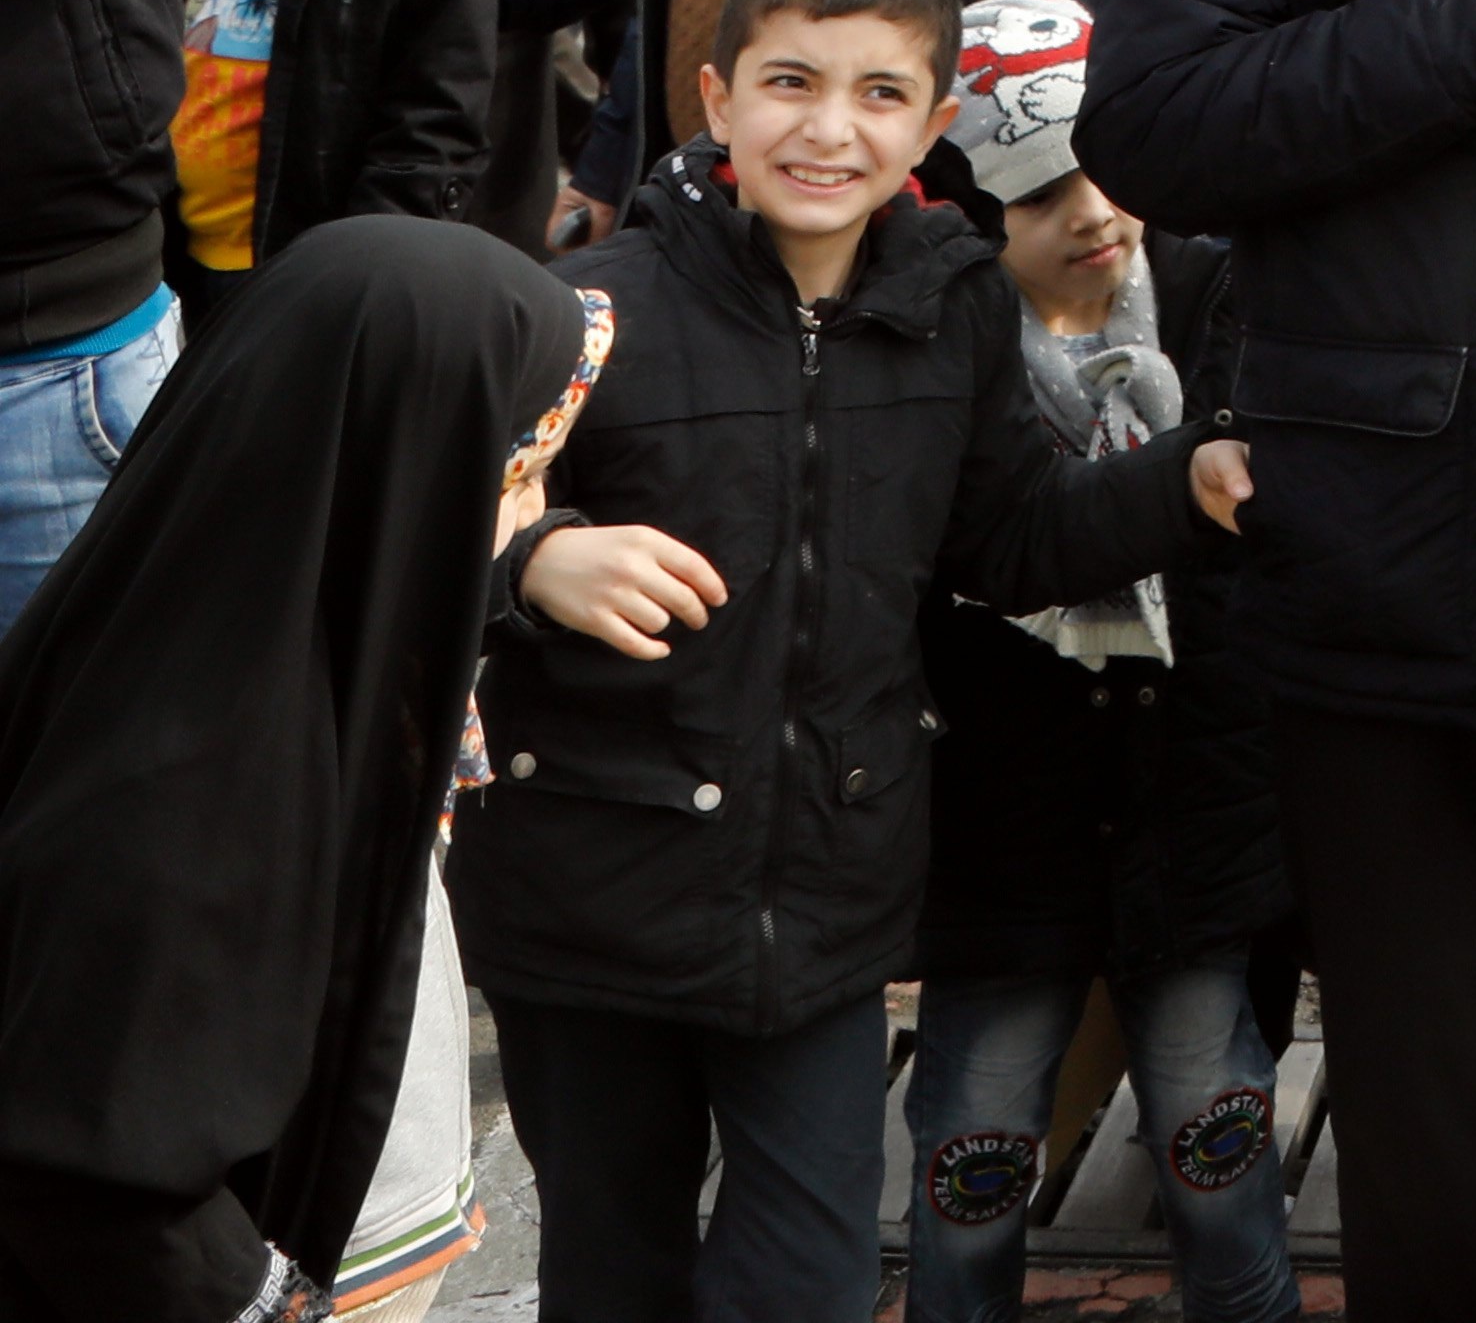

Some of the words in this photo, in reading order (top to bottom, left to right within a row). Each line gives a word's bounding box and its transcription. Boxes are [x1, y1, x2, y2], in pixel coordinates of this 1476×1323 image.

[1178, 1094, 1266, 1148] LANDSTAR
[1177, 1155, 1217, 1187] TEAM
[934, 1176, 965, 1218] TEAM
